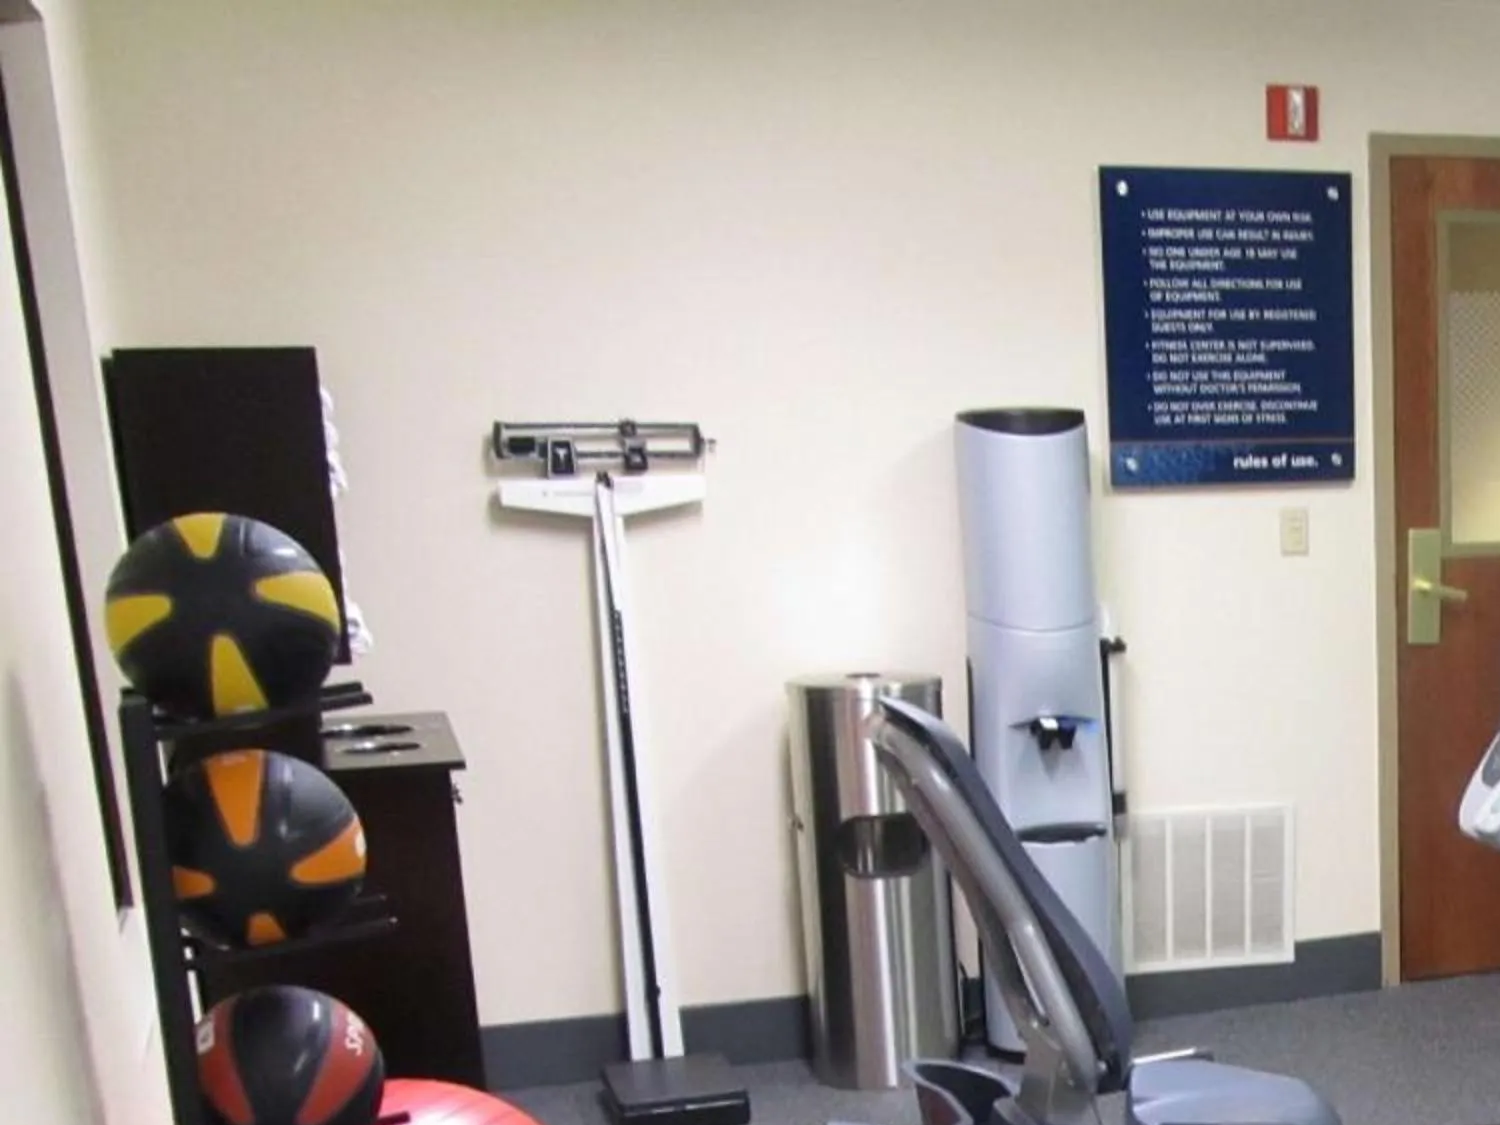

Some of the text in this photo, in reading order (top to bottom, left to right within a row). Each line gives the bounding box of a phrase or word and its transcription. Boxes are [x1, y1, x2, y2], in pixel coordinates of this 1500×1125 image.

[1147, 209, 1164, 222] USE
[1167, 209, 1222, 222] EQUIPMENT
[1225, 209, 1236, 222] AT
[1239, 209, 1265, 222] YOUR
[1266, 209, 1291, 222] OWN
[1148, 228, 1194, 241] IMPROPER
[1197, 228, 1213, 241] USE
[1216, 228, 1236, 241] CAN
[1238, 228, 1269, 241] RESULT
[1271, 228, 1281, 241] IN
[1149, 247, 1163, 259] NO
[1165, 247, 1186, 259] ONE
[1188, 247, 1221, 259] UNDER
[1223, 247, 1242, 259] AGE
[1257, 247, 1278, 259] MAY
[1281, 247, 1297, 259] USE
[1149, 260, 1167, 271] THE
[1150, 278, 1302, 290] FOLLOW ALL DIRECTIONS FOR USE
[1150, 291, 1163, 302] OF
[1151, 309, 1317, 320] EQUIPMENT FOR USE BY REGISTERED
[1151, 322, 1186, 333] GUESTS
[1151, 340, 1188, 351] FITNESS
[1190, 340, 1225, 351] CENTER
[1237, 340, 1258, 351] NOT
[1152, 353, 1167, 363] DO
[1170, 353, 1189, 363] NOT
[1192, 353, 1232, 363] EXERCISE
[1152, 370, 1286, 381] DO NOT USE THIS EQUIPMENT
[1153, 383, 1197, 395] WITHOUT
[1154, 401, 1168, 412] DO
[1170, 401, 1189, 412] NOT
[1192, 401, 1216, 412] OVER
[1260, 401, 1317, 412] DISCONTINUE
[1154, 413, 1171, 425] USE
[1174, 413, 1185, 425] AT
[1187, 413, 1212, 425] FIRST
[1241, 413, 1253, 425] OF
[1233, 453, 1319, 469] rules of use.
